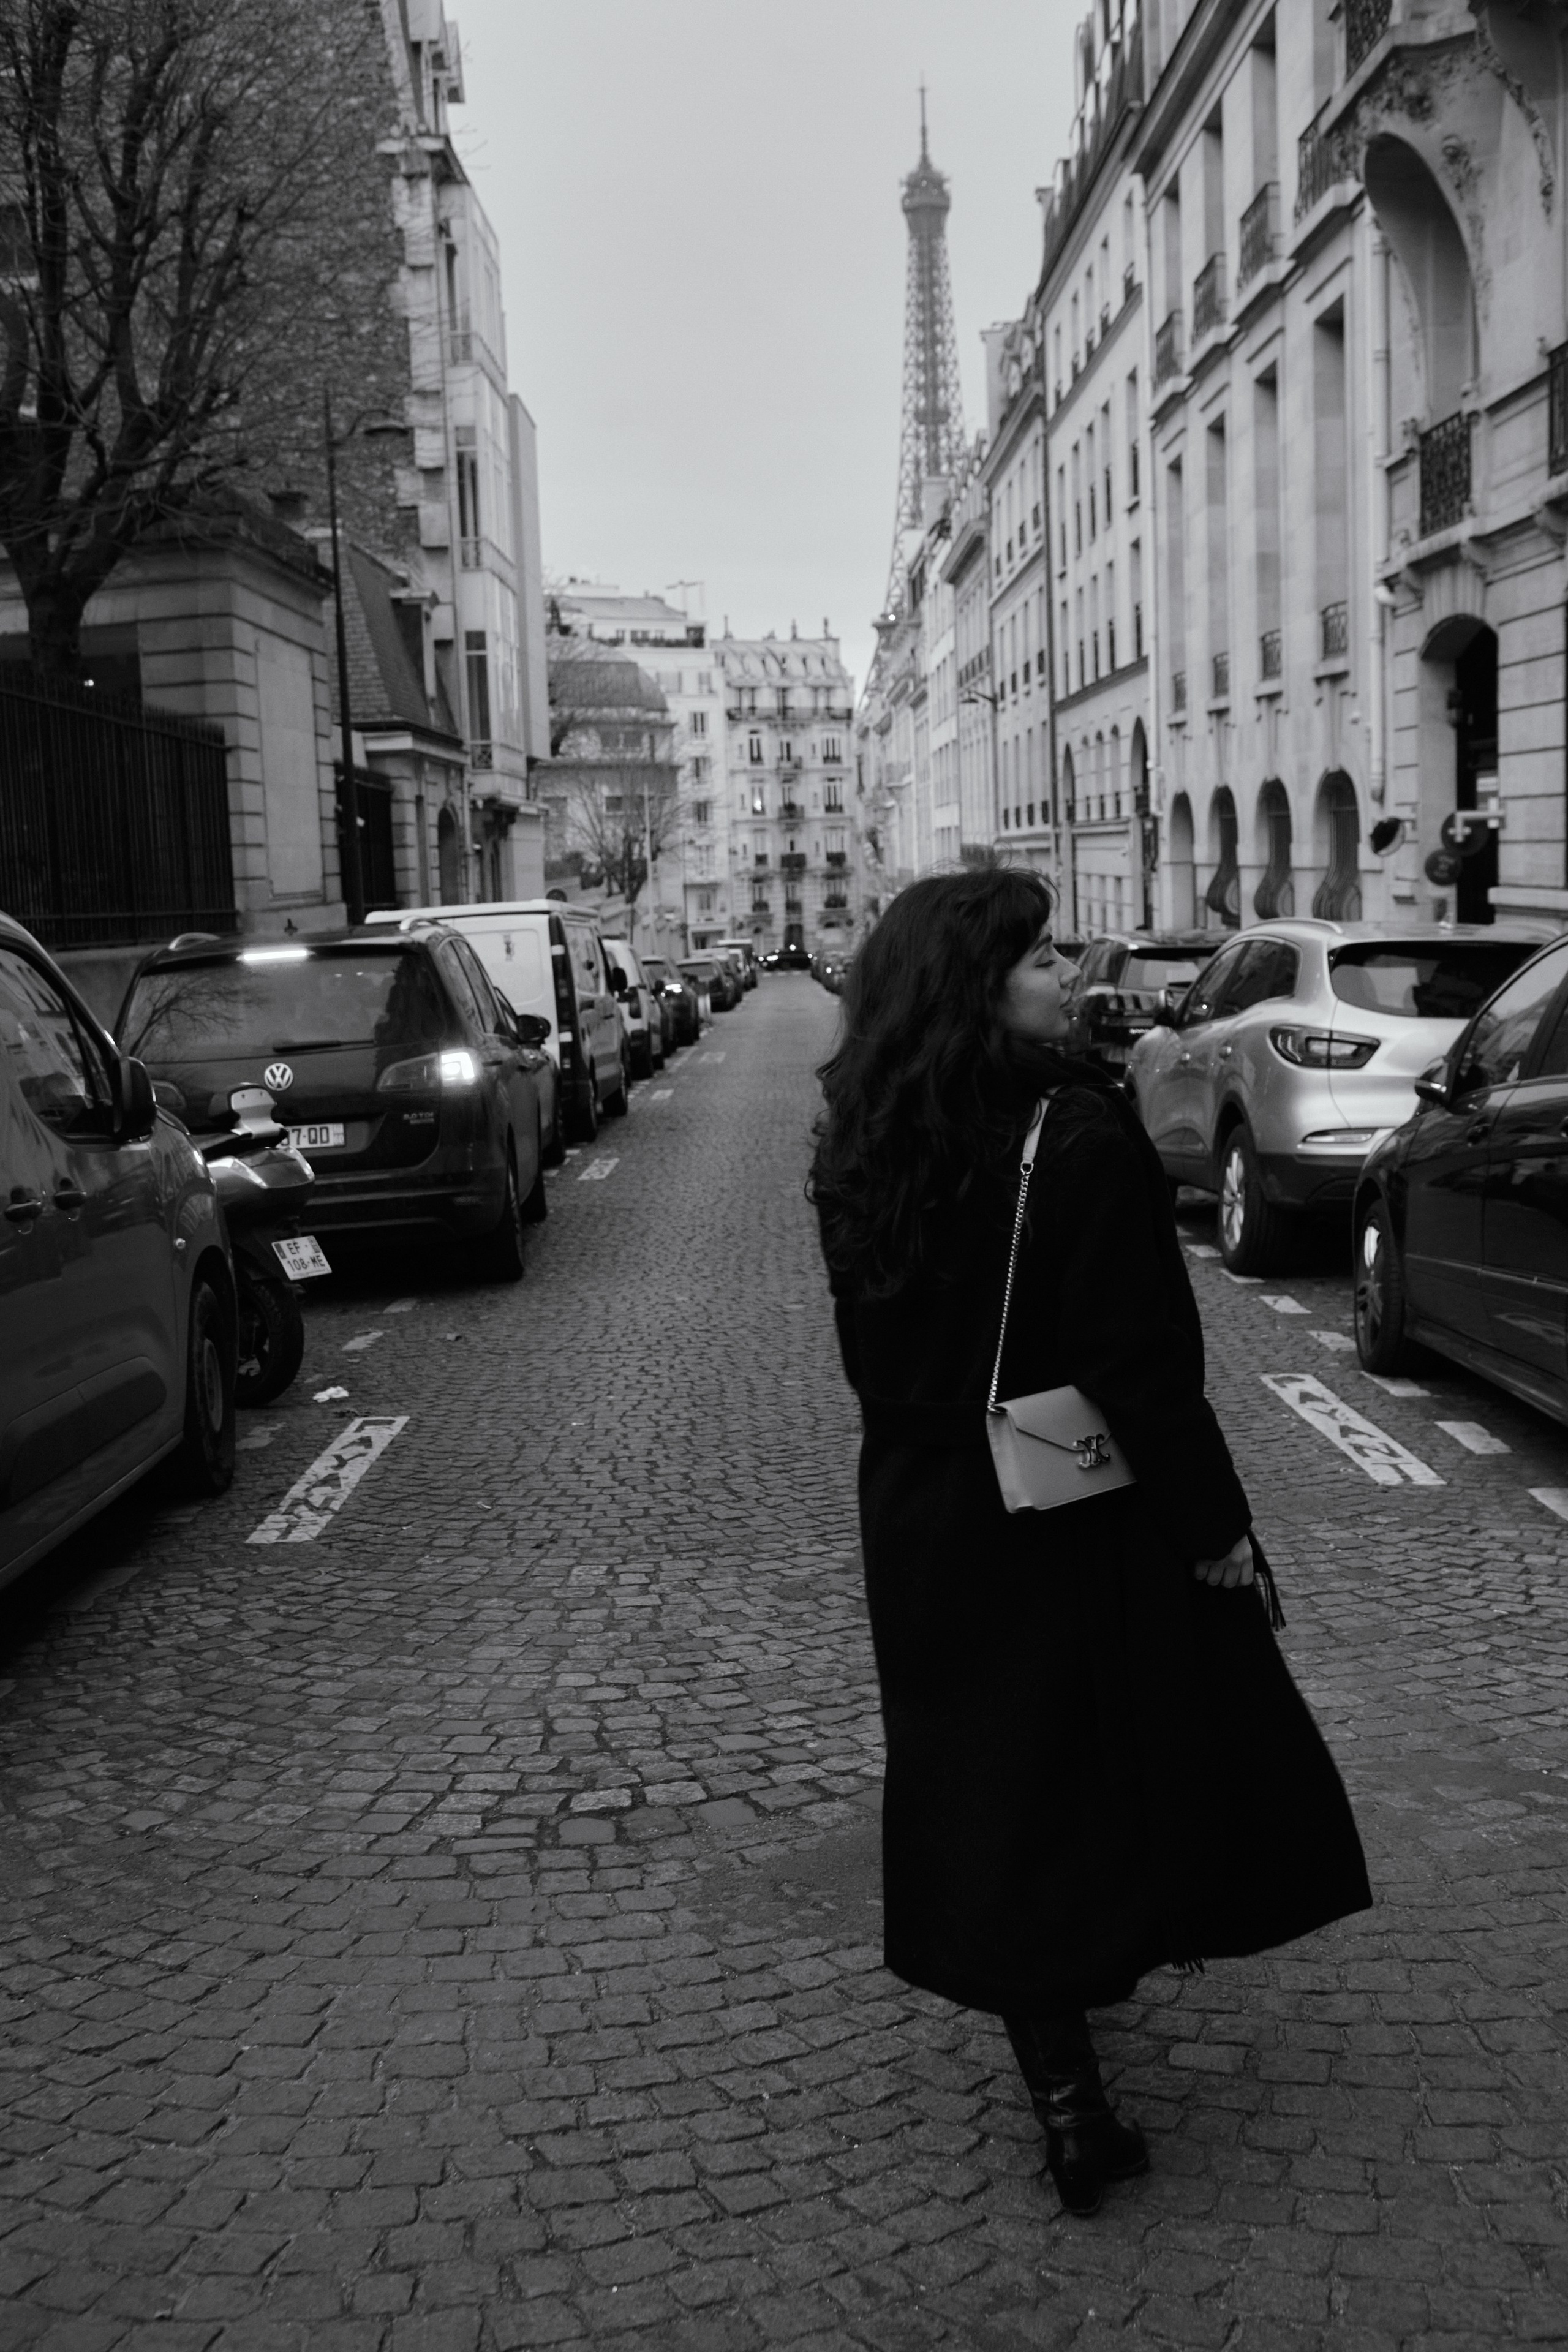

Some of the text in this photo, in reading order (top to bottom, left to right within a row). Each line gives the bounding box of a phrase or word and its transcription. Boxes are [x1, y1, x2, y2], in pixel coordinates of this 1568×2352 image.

[287, 1254, 325, 1272] 108-ME
[276, 1419, 396, 1541] PAYANT
[1270, 1376, 1414, 1482] PAYANT
